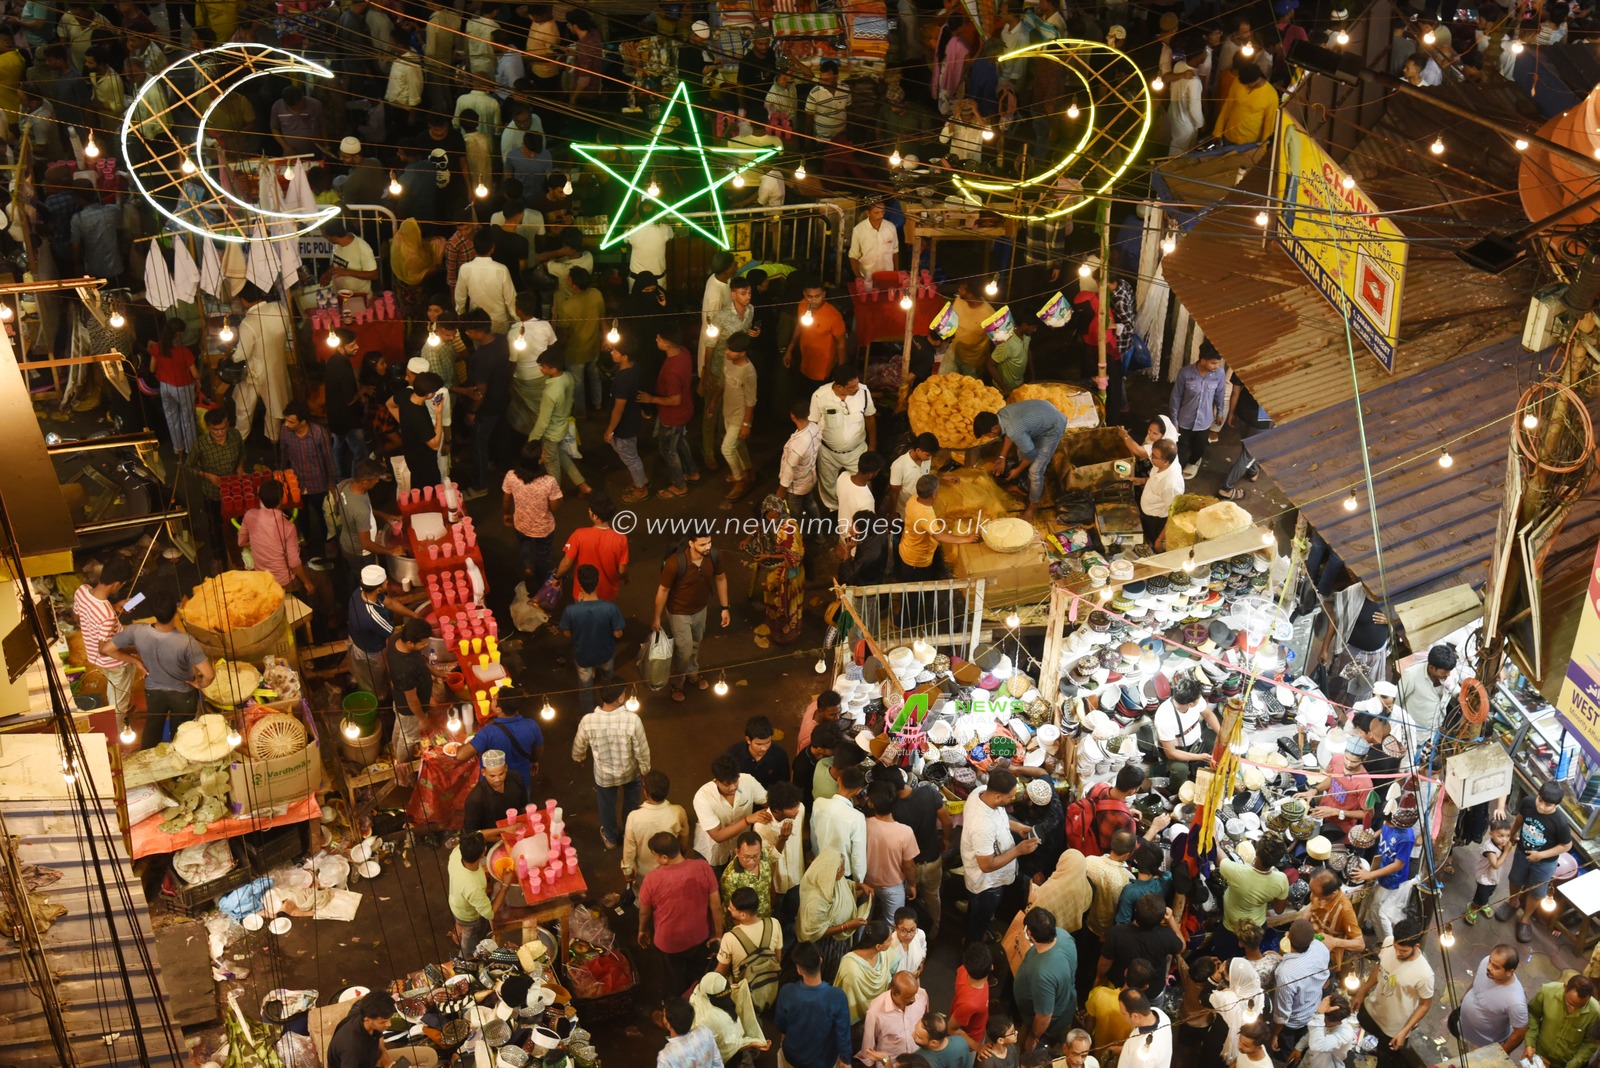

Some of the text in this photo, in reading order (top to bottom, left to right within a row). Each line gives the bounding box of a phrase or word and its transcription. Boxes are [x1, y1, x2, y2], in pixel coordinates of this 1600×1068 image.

[1322, 162, 1381, 235] CHANK
[313, 241, 333, 254] POLI
[1277, 222, 1295, 253] NEW
[1294, 240, 1321, 284] HAJRA
[1346, 218, 1373, 251] PRVATE
[1373, 248, 1400, 281] LIMITED
[1569, 706, 1588, 731] Minority
[1571, 688, 1600, 727] WEST
[267, 759, 311, 778] Vardhman
